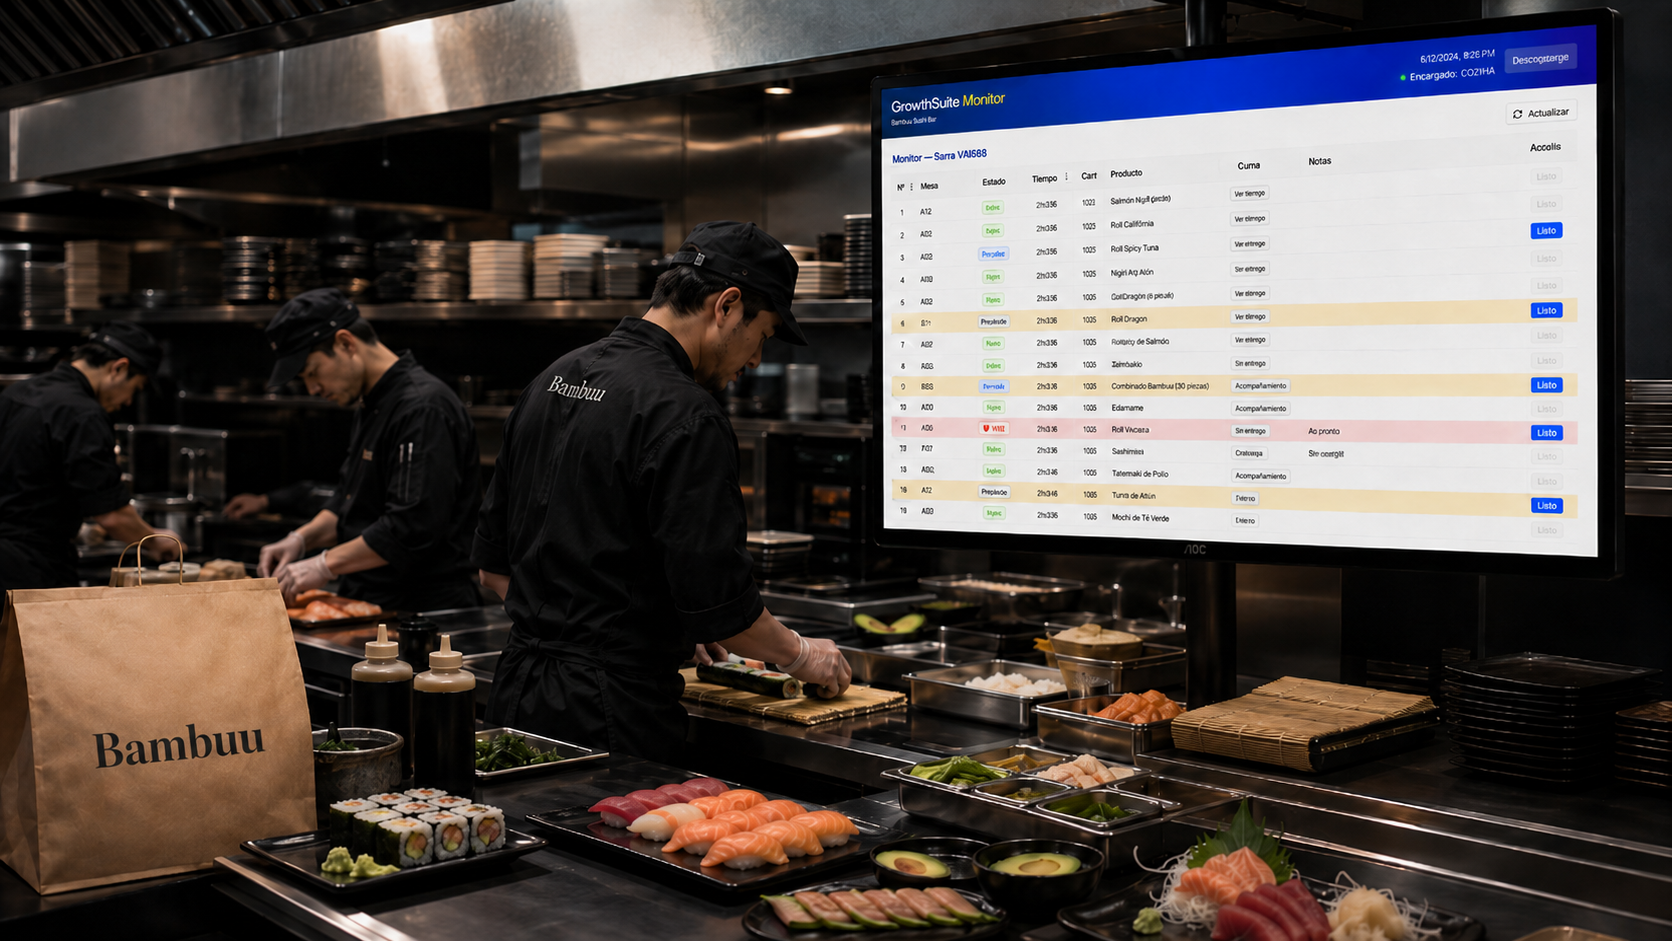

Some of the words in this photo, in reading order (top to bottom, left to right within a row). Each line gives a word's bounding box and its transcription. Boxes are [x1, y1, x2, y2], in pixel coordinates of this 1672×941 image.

[1482, 49, 1496, 58] PM
[1410, 70, 1458, 82] Encargado:
[891, 96, 960, 114] GrowthSuite
[962, 92, 1006, 107] Monitor
[1528, 108, 1570, 118] Actualizar
[892, 154, 922, 164] Monitor
[934, 152, 956, 162] Sarra
[1308, 157, 1333, 166] Notas
[1031, 174, 1058, 184] Tiempo
[1080, 171, 1098, 181] Cart
[1110, 169, 1144, 179] Producto
[920, 182, 939, 191] Mesa
[982, 177, 1007, 187] Estado
[1124, 244, 1142, 253] Spicy
[1124, 315, 1148, 324] Dragon
[547, 374, 606, 402] Bambuu
[1187, 382, 1210, 391] piezas)
[92, 724, 266, 770] Bambuu
